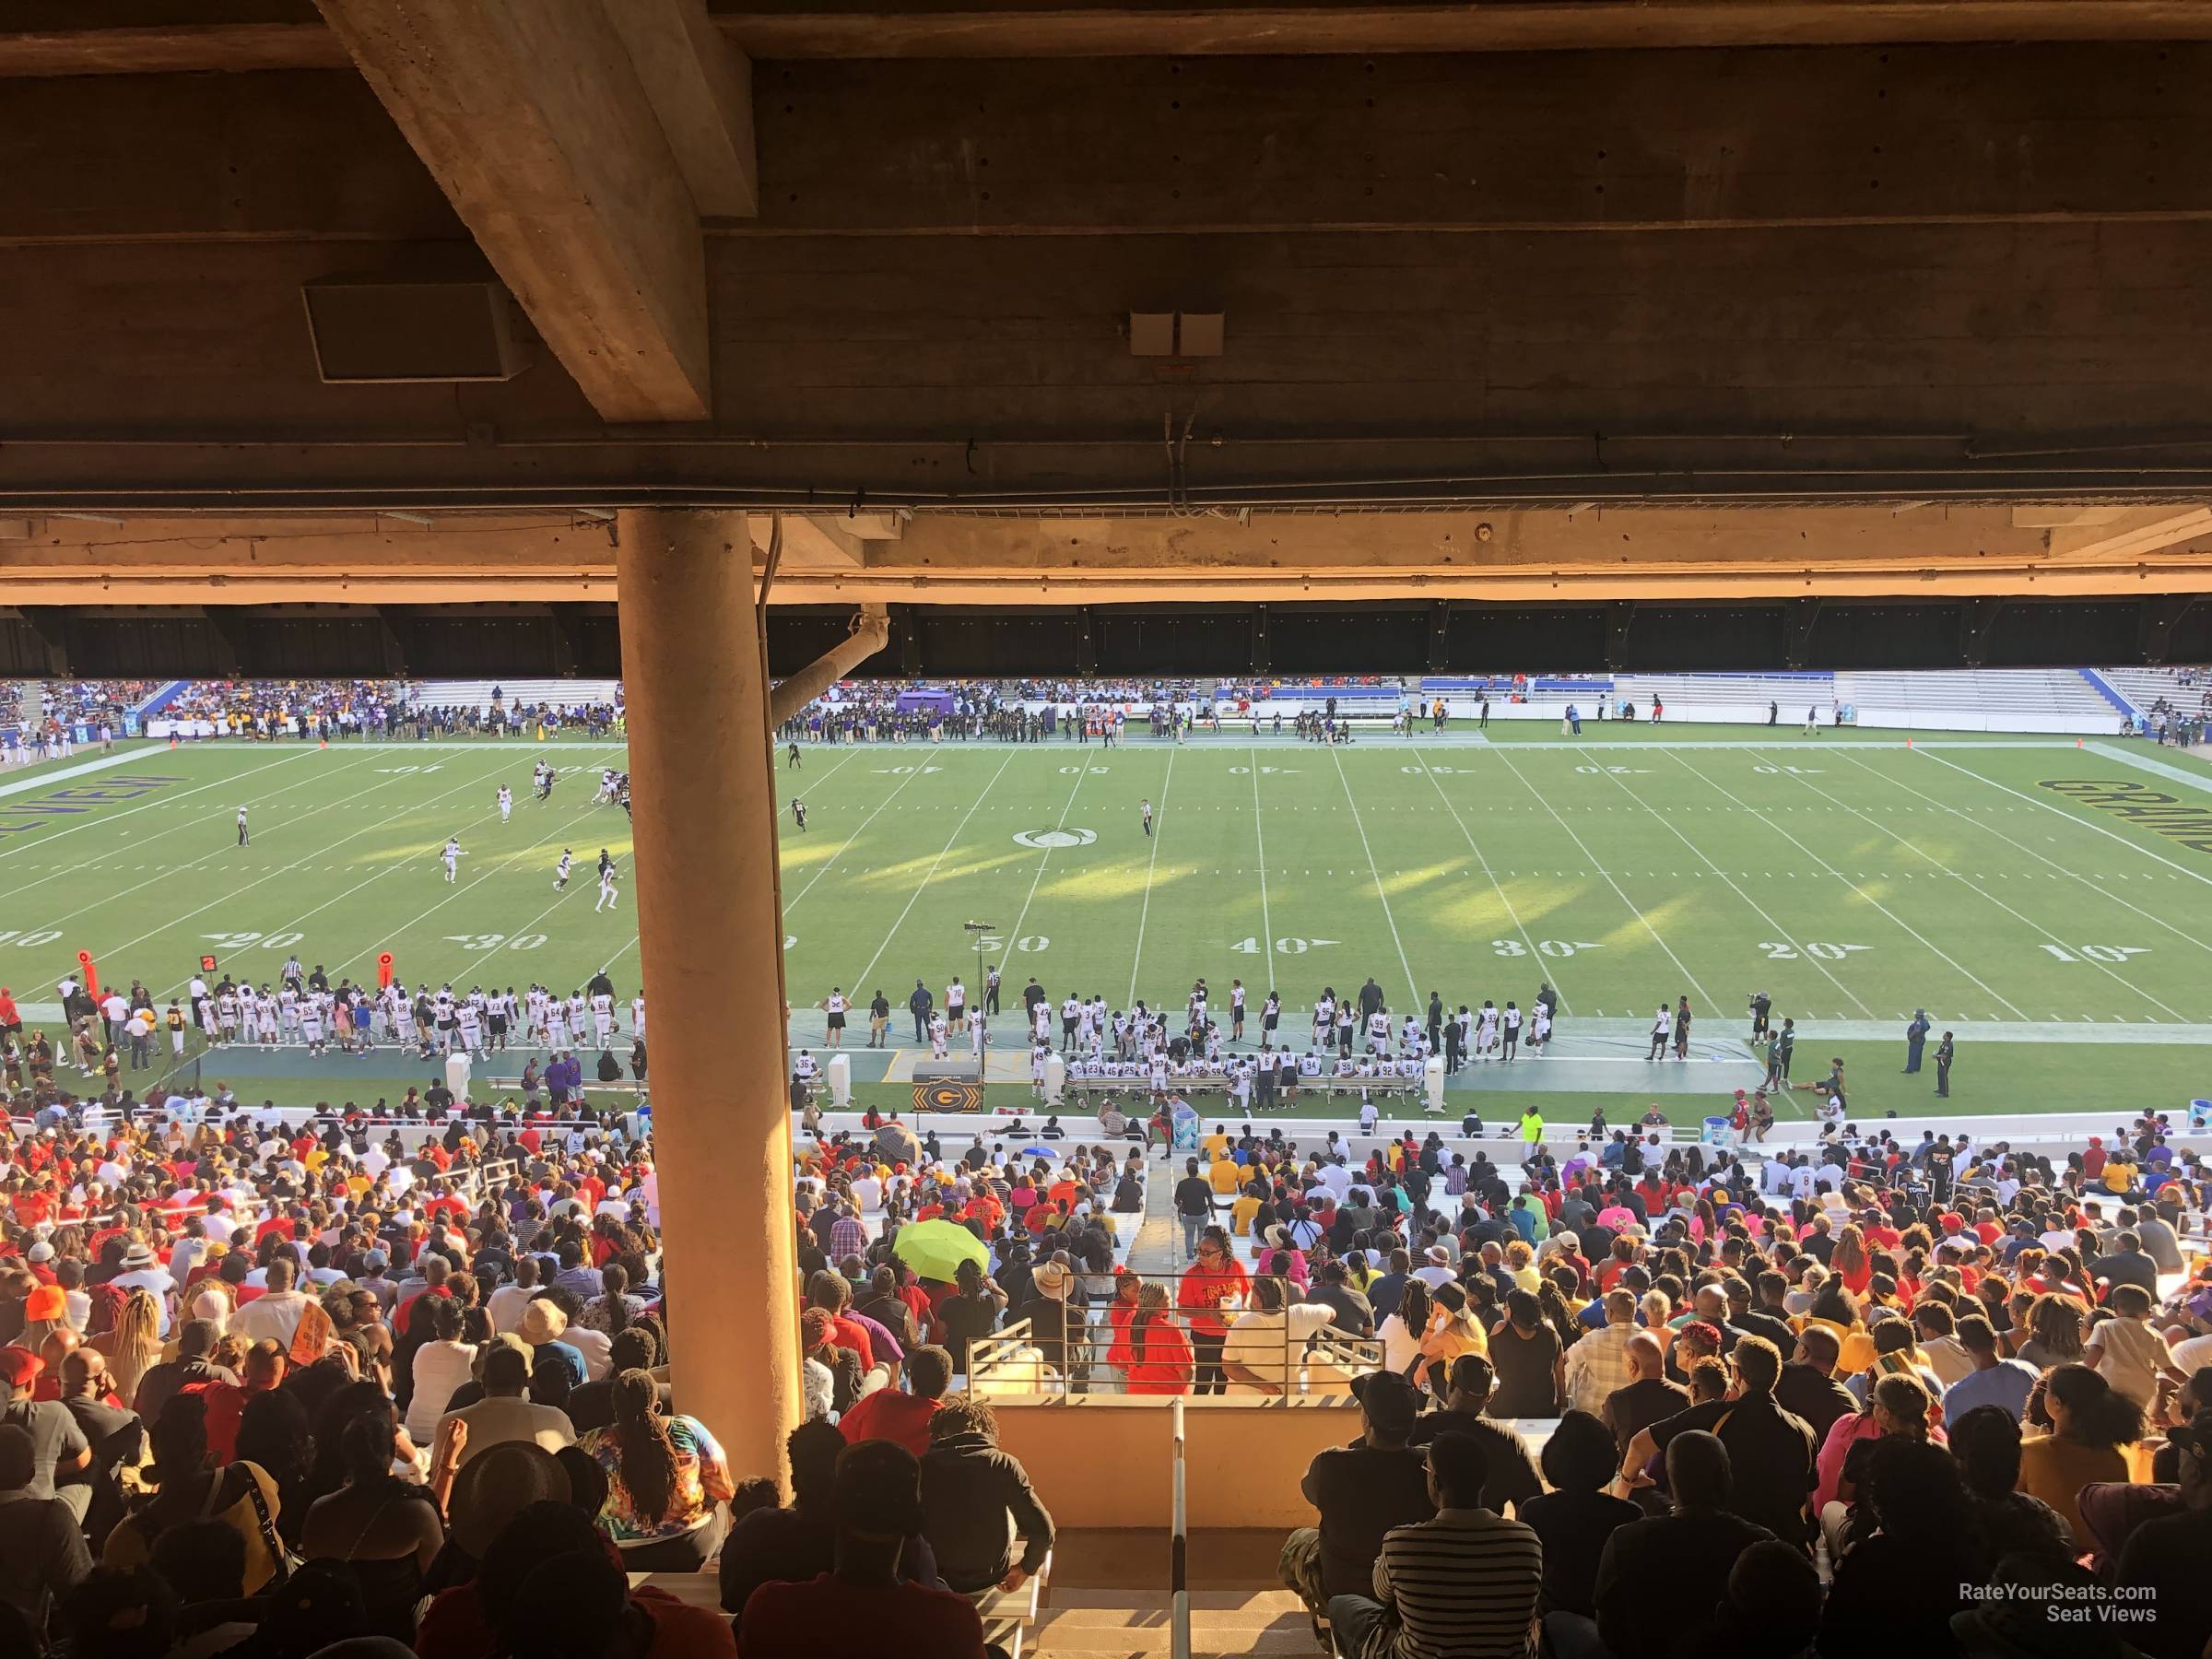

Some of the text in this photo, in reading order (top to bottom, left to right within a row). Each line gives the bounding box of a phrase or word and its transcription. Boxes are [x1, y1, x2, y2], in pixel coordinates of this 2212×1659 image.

[463, 934, 547, 949] 30
[971, 935, 1050, 951] 50
[1230, 937, 1307, 954] 40
[1491, 940, 1575, 956] 30
[1759, 942, 1847, 959] 20
[2039, 944, 2128, 961] 10
[203, 957, 214, 970] 2
[398, 1003, 406, 1012] 68
[1322, 1007, 1330, 1016] 96
[463, 1013, 472, 1021] 72
[1488, 1015, 1496, 1023] 93
[1374, 1020, 1383, 1029] 99
[800, 1060, 808, 1068] 36
[1155, 1059, 1163, 1067] 37
[1306, 1061, 1315, 1069] 94
[1088, 1065, 1098, 1074] 23
[1107, 1067, 1116, 1076] 46
[1125, 1065, 1135, 1074] 25
[1382, 1066, 1392, 1076] 92
[1406, 1065, 1413, 1074] 91
[937, 1091, 961, 1104] G
[243, 1136, 253, 1147] 3
[1804, 1175, 1809, 1186] 8
[1916, 1193, 1925, 1208] 1
[974, 1206, 991, 1217] 92
